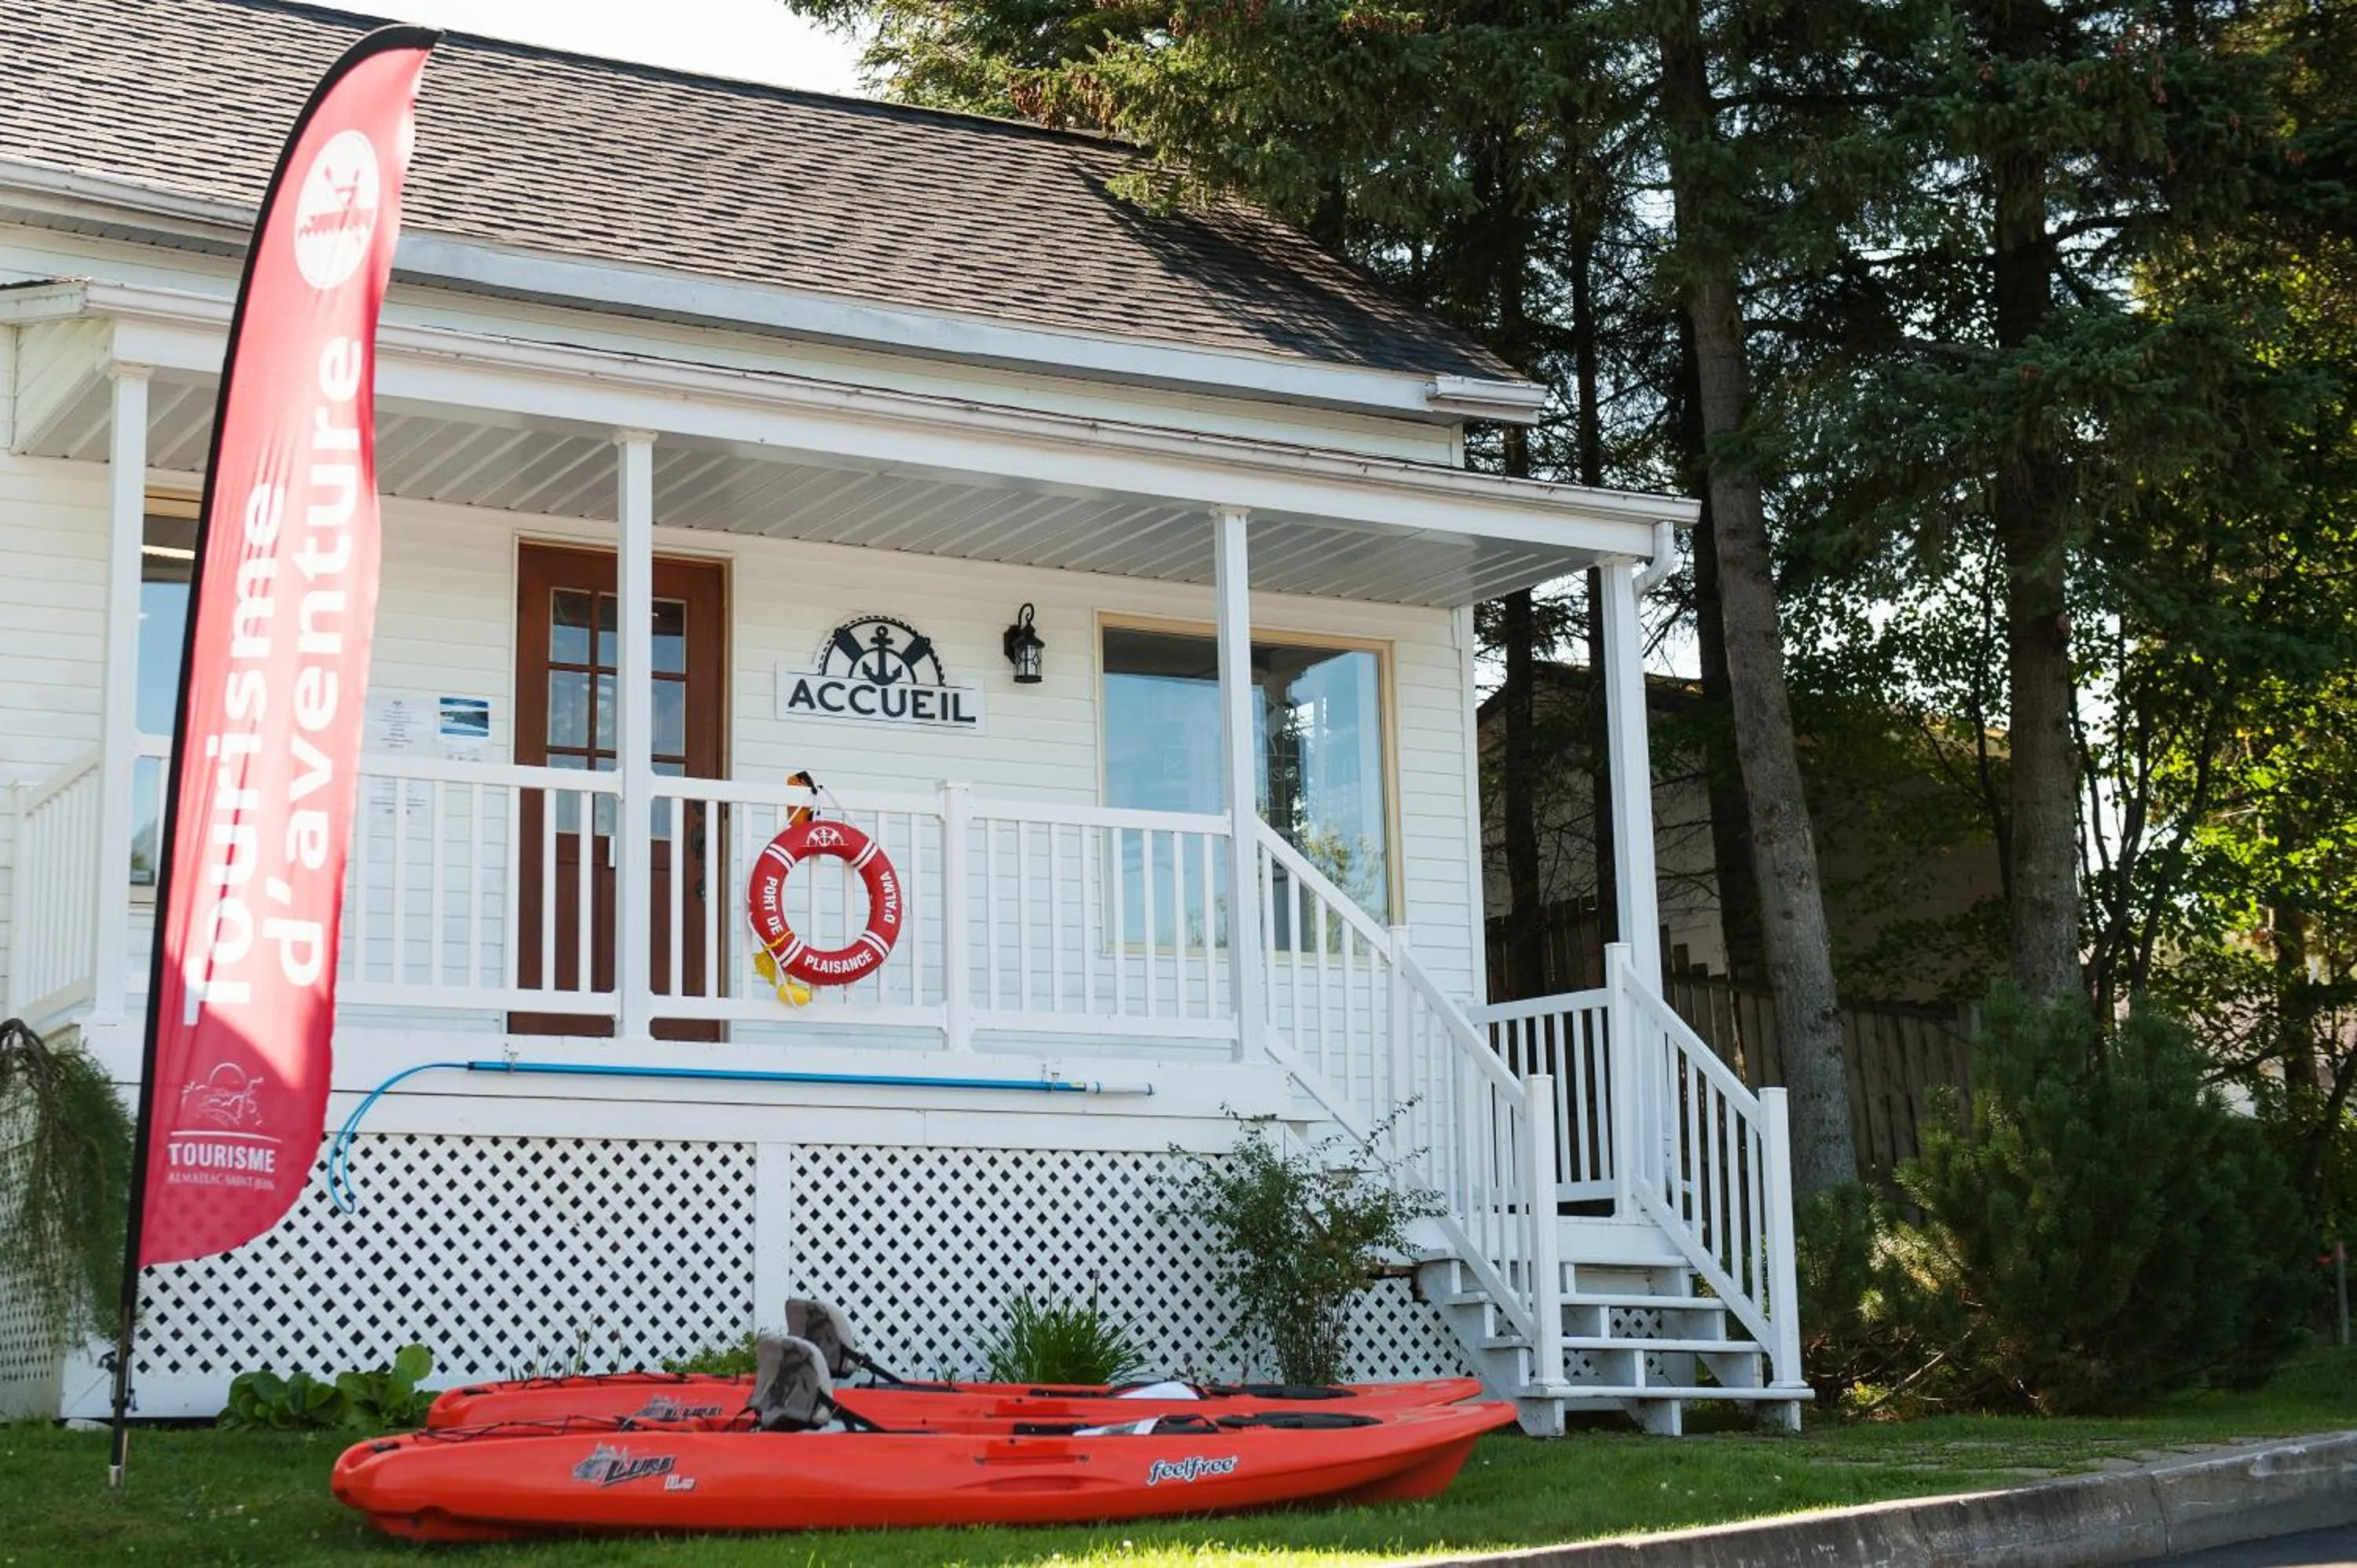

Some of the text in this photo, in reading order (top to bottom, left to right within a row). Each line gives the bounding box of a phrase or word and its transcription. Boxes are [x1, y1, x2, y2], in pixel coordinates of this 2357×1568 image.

[264, 334, 363, 987] d'aventure
[788, 679, 977, 723] ACCUEIL
[183, 482, 285, 1026] Tourisme
[762, 876, 783, 936] PORT DE
[880, 870, 897, 925] D'ALMA
[804, 949, 874, 973] PLAISANCE
[167, 1143, 275, 1173] TOURISME
[1147, 1456, 1236, 1486] feelfree
